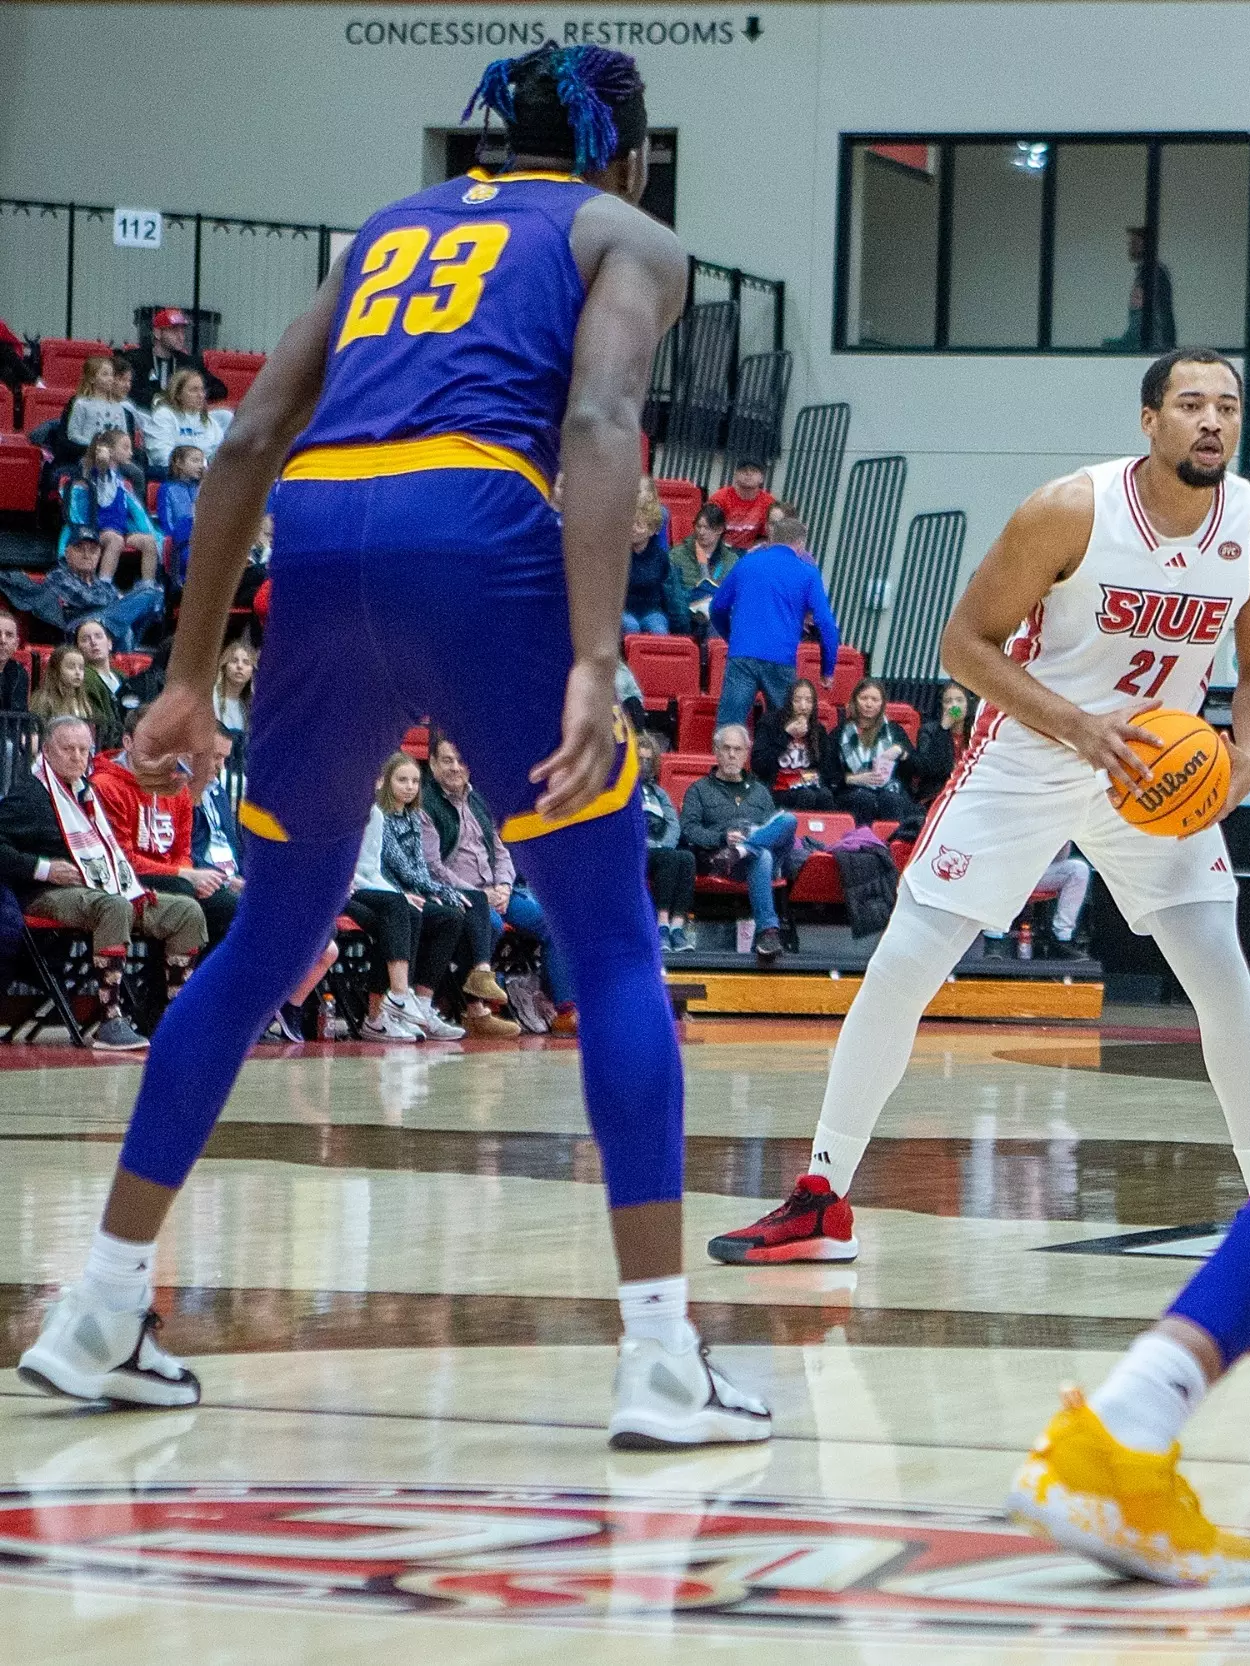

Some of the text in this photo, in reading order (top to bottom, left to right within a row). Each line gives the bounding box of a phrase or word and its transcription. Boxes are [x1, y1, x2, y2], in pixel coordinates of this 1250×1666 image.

[563, 22, 733, 46] RESTROOMS
[119, 218, 156, 240] 112
[334, 223, 512, 353] 23
[1095, 584, 1233, 644] SIUE
[1113, 650, 1180, 698] 21
[1136, 750, 1209, 813] Wilson
